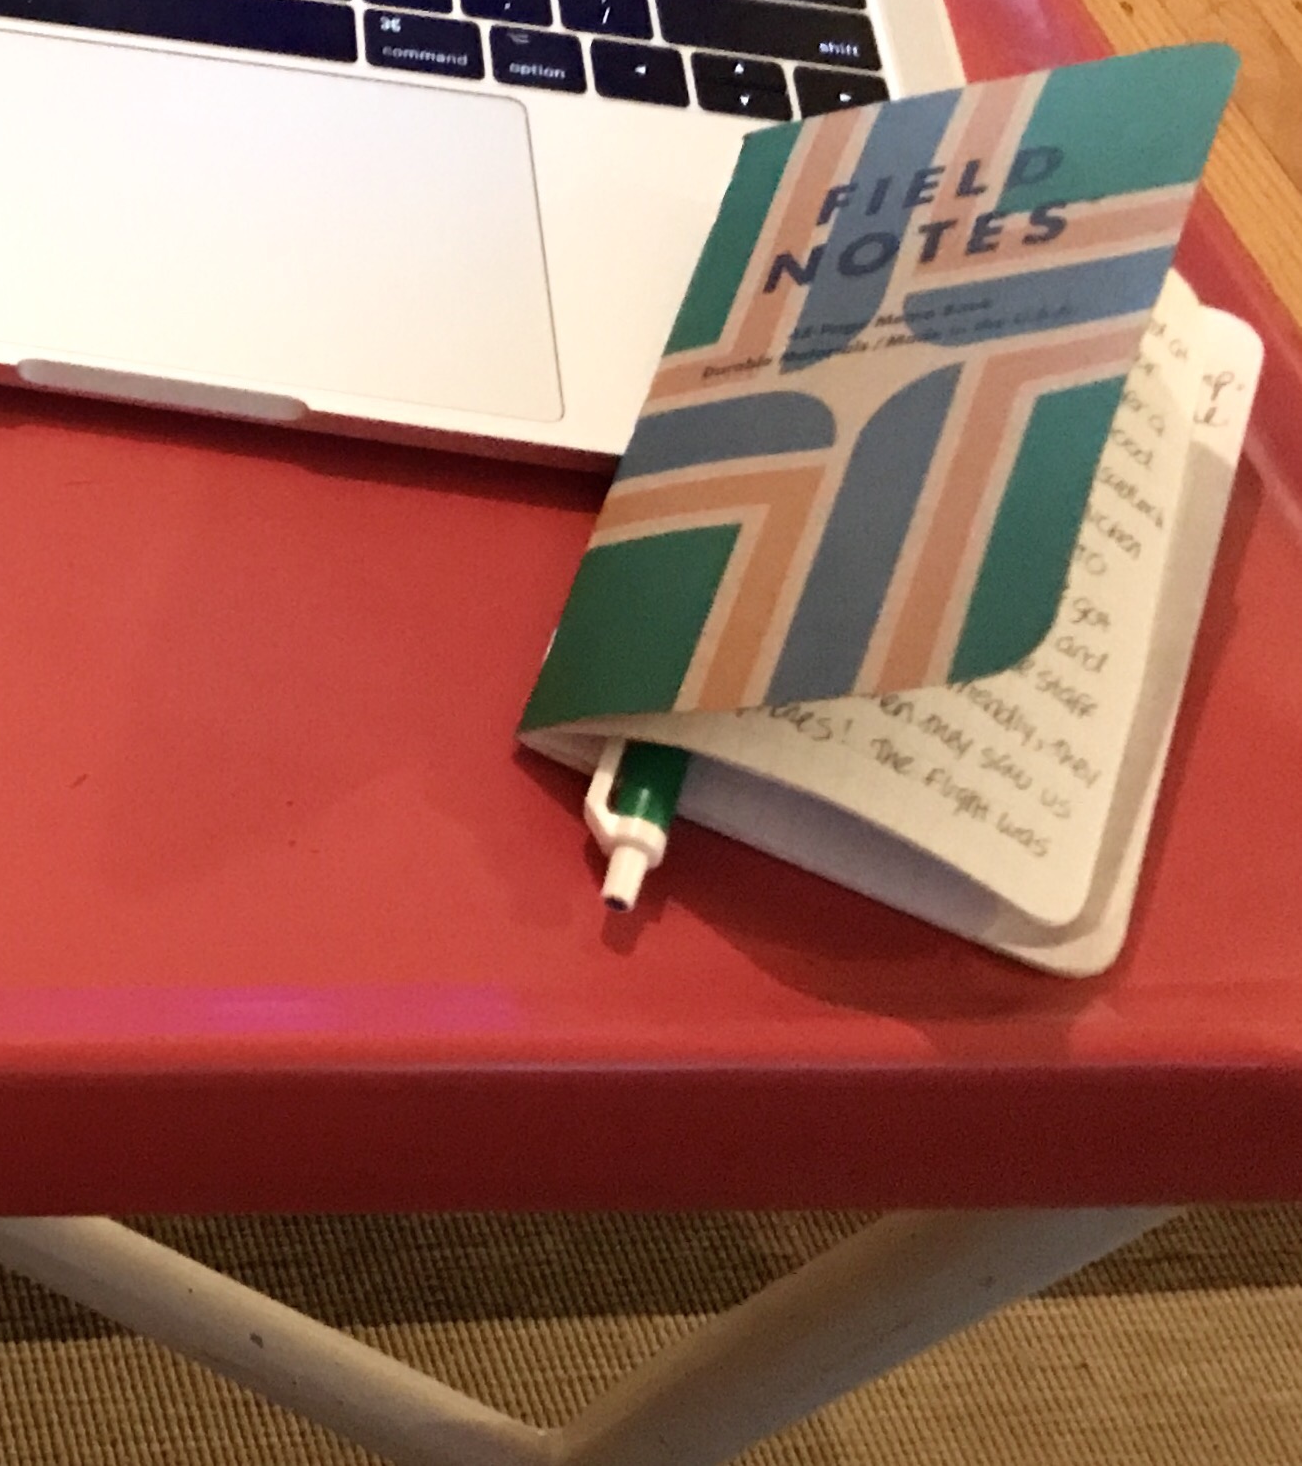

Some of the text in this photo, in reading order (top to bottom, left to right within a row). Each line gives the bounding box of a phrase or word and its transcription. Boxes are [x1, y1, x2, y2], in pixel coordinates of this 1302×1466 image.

[380, 44, 469, 68] command
[819, 41, 858, 57] shift
[509, 62, 566, 79] option
[816, 145, 1064, 227] FIELD
[761, 201, 1067, 295] NOTES
[701, 355, 773, 380] Durable
